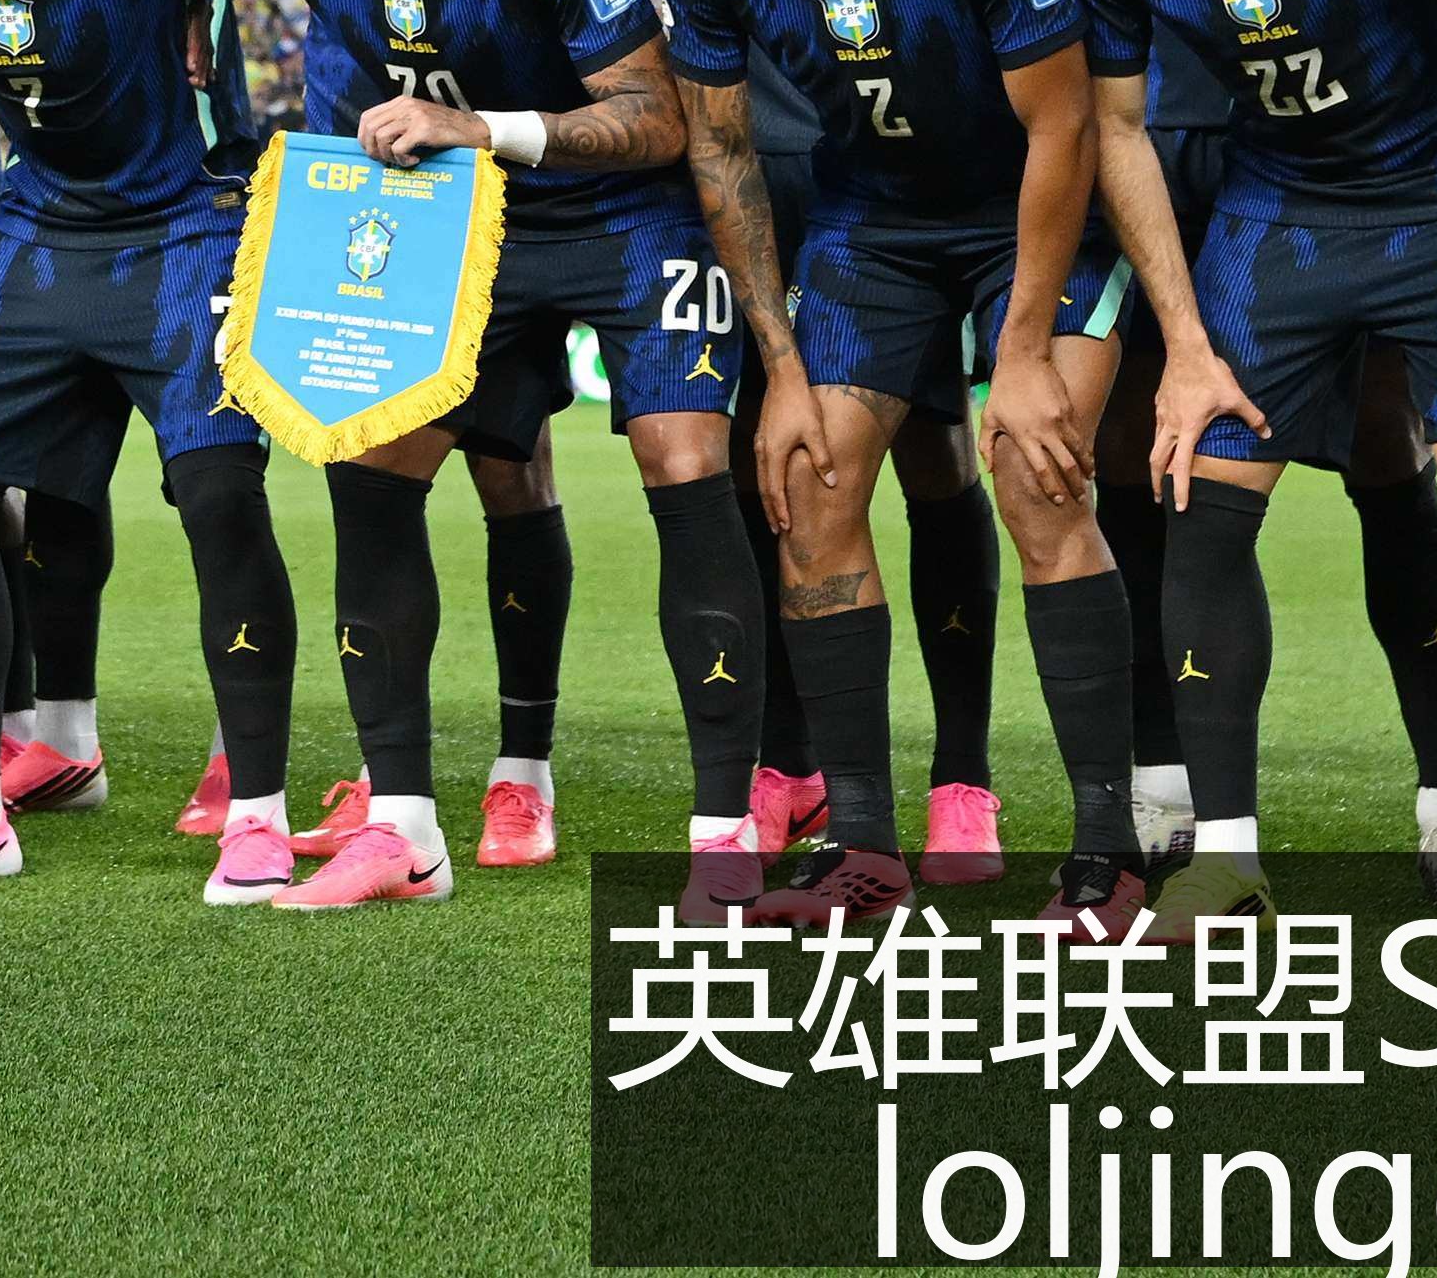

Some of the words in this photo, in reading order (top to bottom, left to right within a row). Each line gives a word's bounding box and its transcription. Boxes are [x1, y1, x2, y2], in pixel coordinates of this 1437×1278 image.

[840, 6, 860, 16] CBF
[388, 37, 439, 54] BRASIL
[1237, 22, 1299, 45] BRASIL
[835, 46, 892, 62] BRASIL
[1241, 47, 1349, 117] 22
[8, 76, 42, 127] 7
[854, 77, 914, 136] 2
[307, 161, 371, 193] CBF
[337, 283, 385, 300] BRASIL
[661, 259, 733, 334] 20
